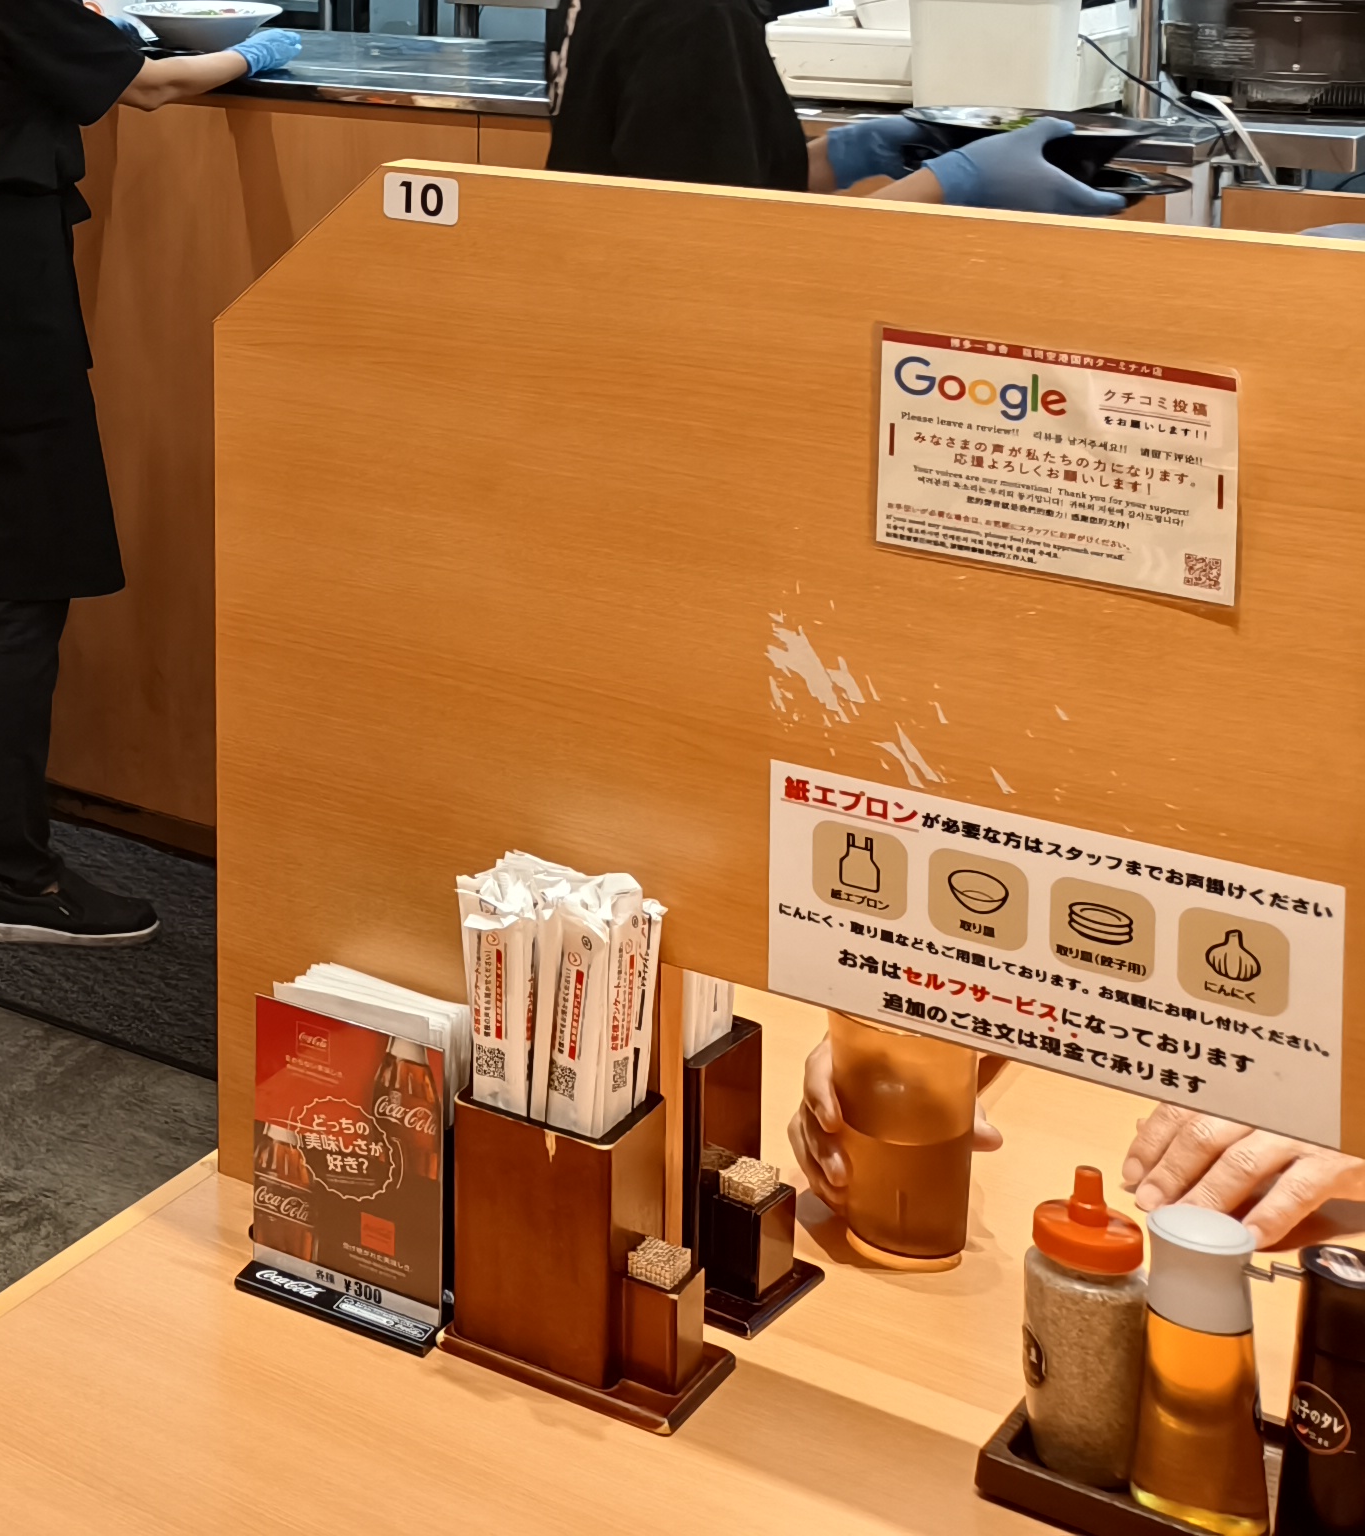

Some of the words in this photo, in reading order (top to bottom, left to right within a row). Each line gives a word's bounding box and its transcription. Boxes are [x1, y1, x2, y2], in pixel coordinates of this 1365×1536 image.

[399, 181, 443, 217] 10
[894, 356, 1067, 421] Google
[1104, 389, 1208, 417] クチコミ投稿
[901, 411, 934, 424] Please
[936, 416, 964, 429] leave
[914, 431, 1196, 488] みなさまの声が私たちの力になります。
[782, 775, 1335, 920] 紙エプロンが必要な方はスタッフまでお声掛けください
[830, 888, 890, 913] 紙エプロン
[958, 918, 996, 939] 取り皿
[1203, 980, 1257, 1004] にんにく
[838, 950, 1255, 1074] お冷はセルフサービスになっております
[883, 991, 1207, 1095] 追加のご注文は現金で承ります
[313, 1114, 370, 1136] どっちの
[374, 1095, 438, 1136] Coca-Cola
[304, 1133, 383, 1158] 美味しさが
[327, 1154, 369, 1175] 好き?
[255, 1185, 310, 1222] Coca-Cola
[256, 1269, 326, 1298] Coca-Cola
[316, 1269, 335, 1285] 各種
[344, 1278, 382, 1305] ¥300
